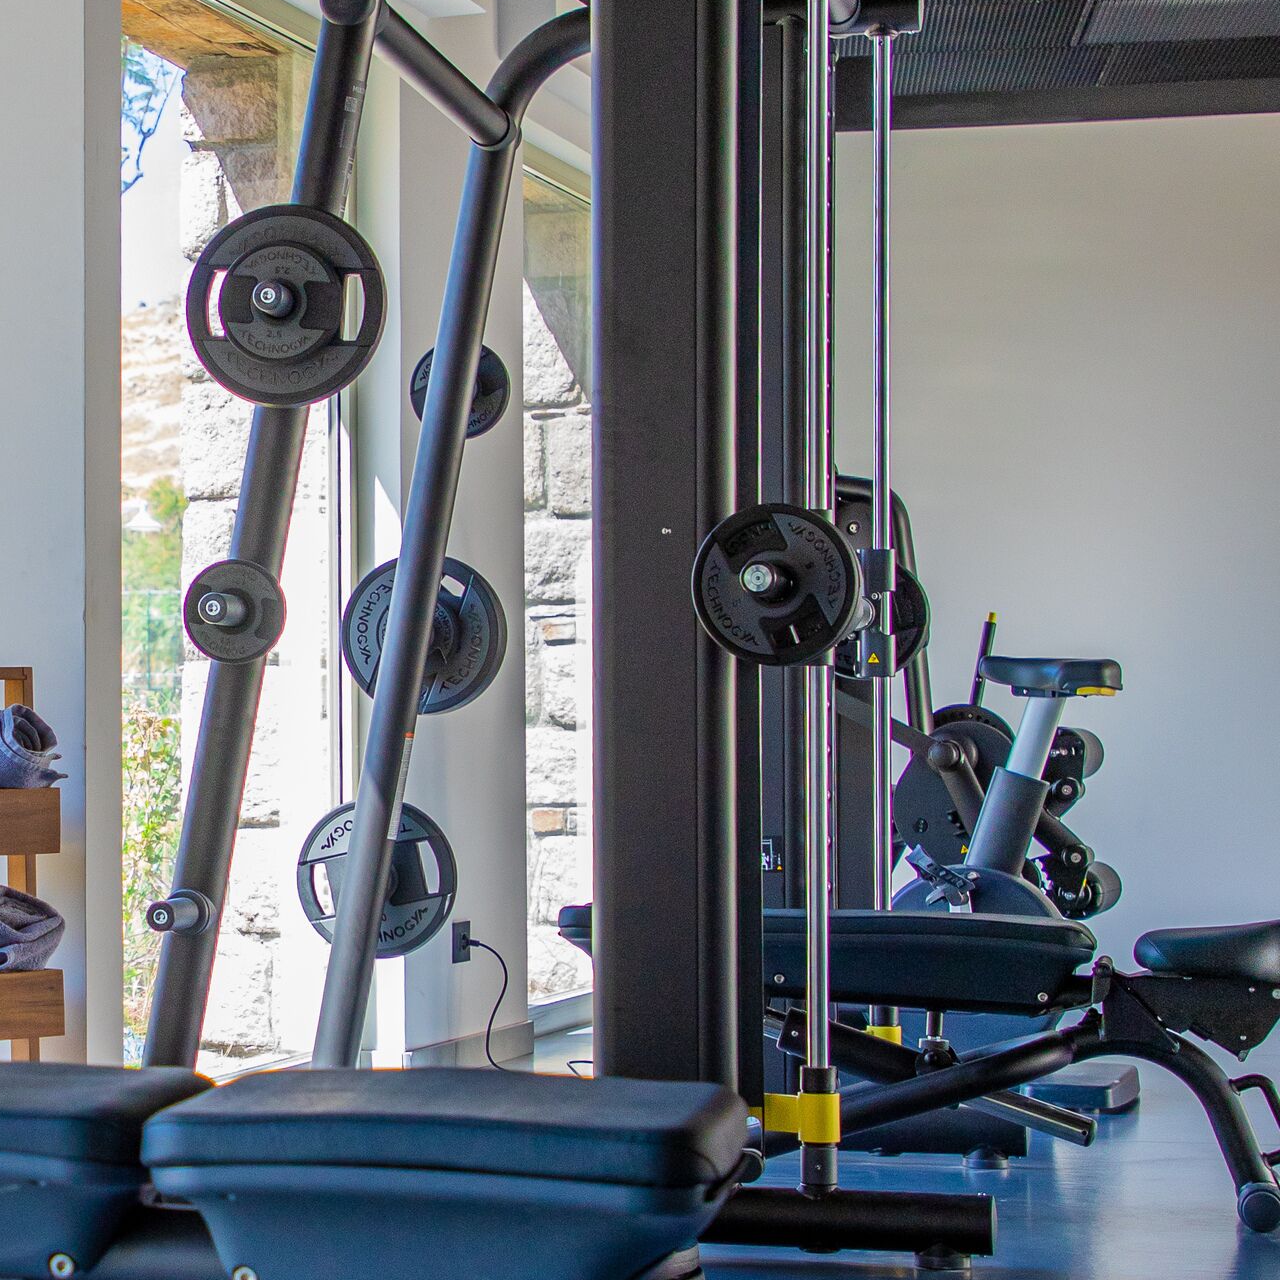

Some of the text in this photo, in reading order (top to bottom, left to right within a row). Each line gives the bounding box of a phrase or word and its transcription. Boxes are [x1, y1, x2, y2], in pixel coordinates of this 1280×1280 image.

[707, 560, 760, 646] TECHNOGYM
[788, 522, 842, 610] TECHNOGYM
[356, 579, 393, 665] ECHNOGYM
[439, 603, 484, 694] TECHNOGYM
[377, 907, 428, 943] NOGYM
